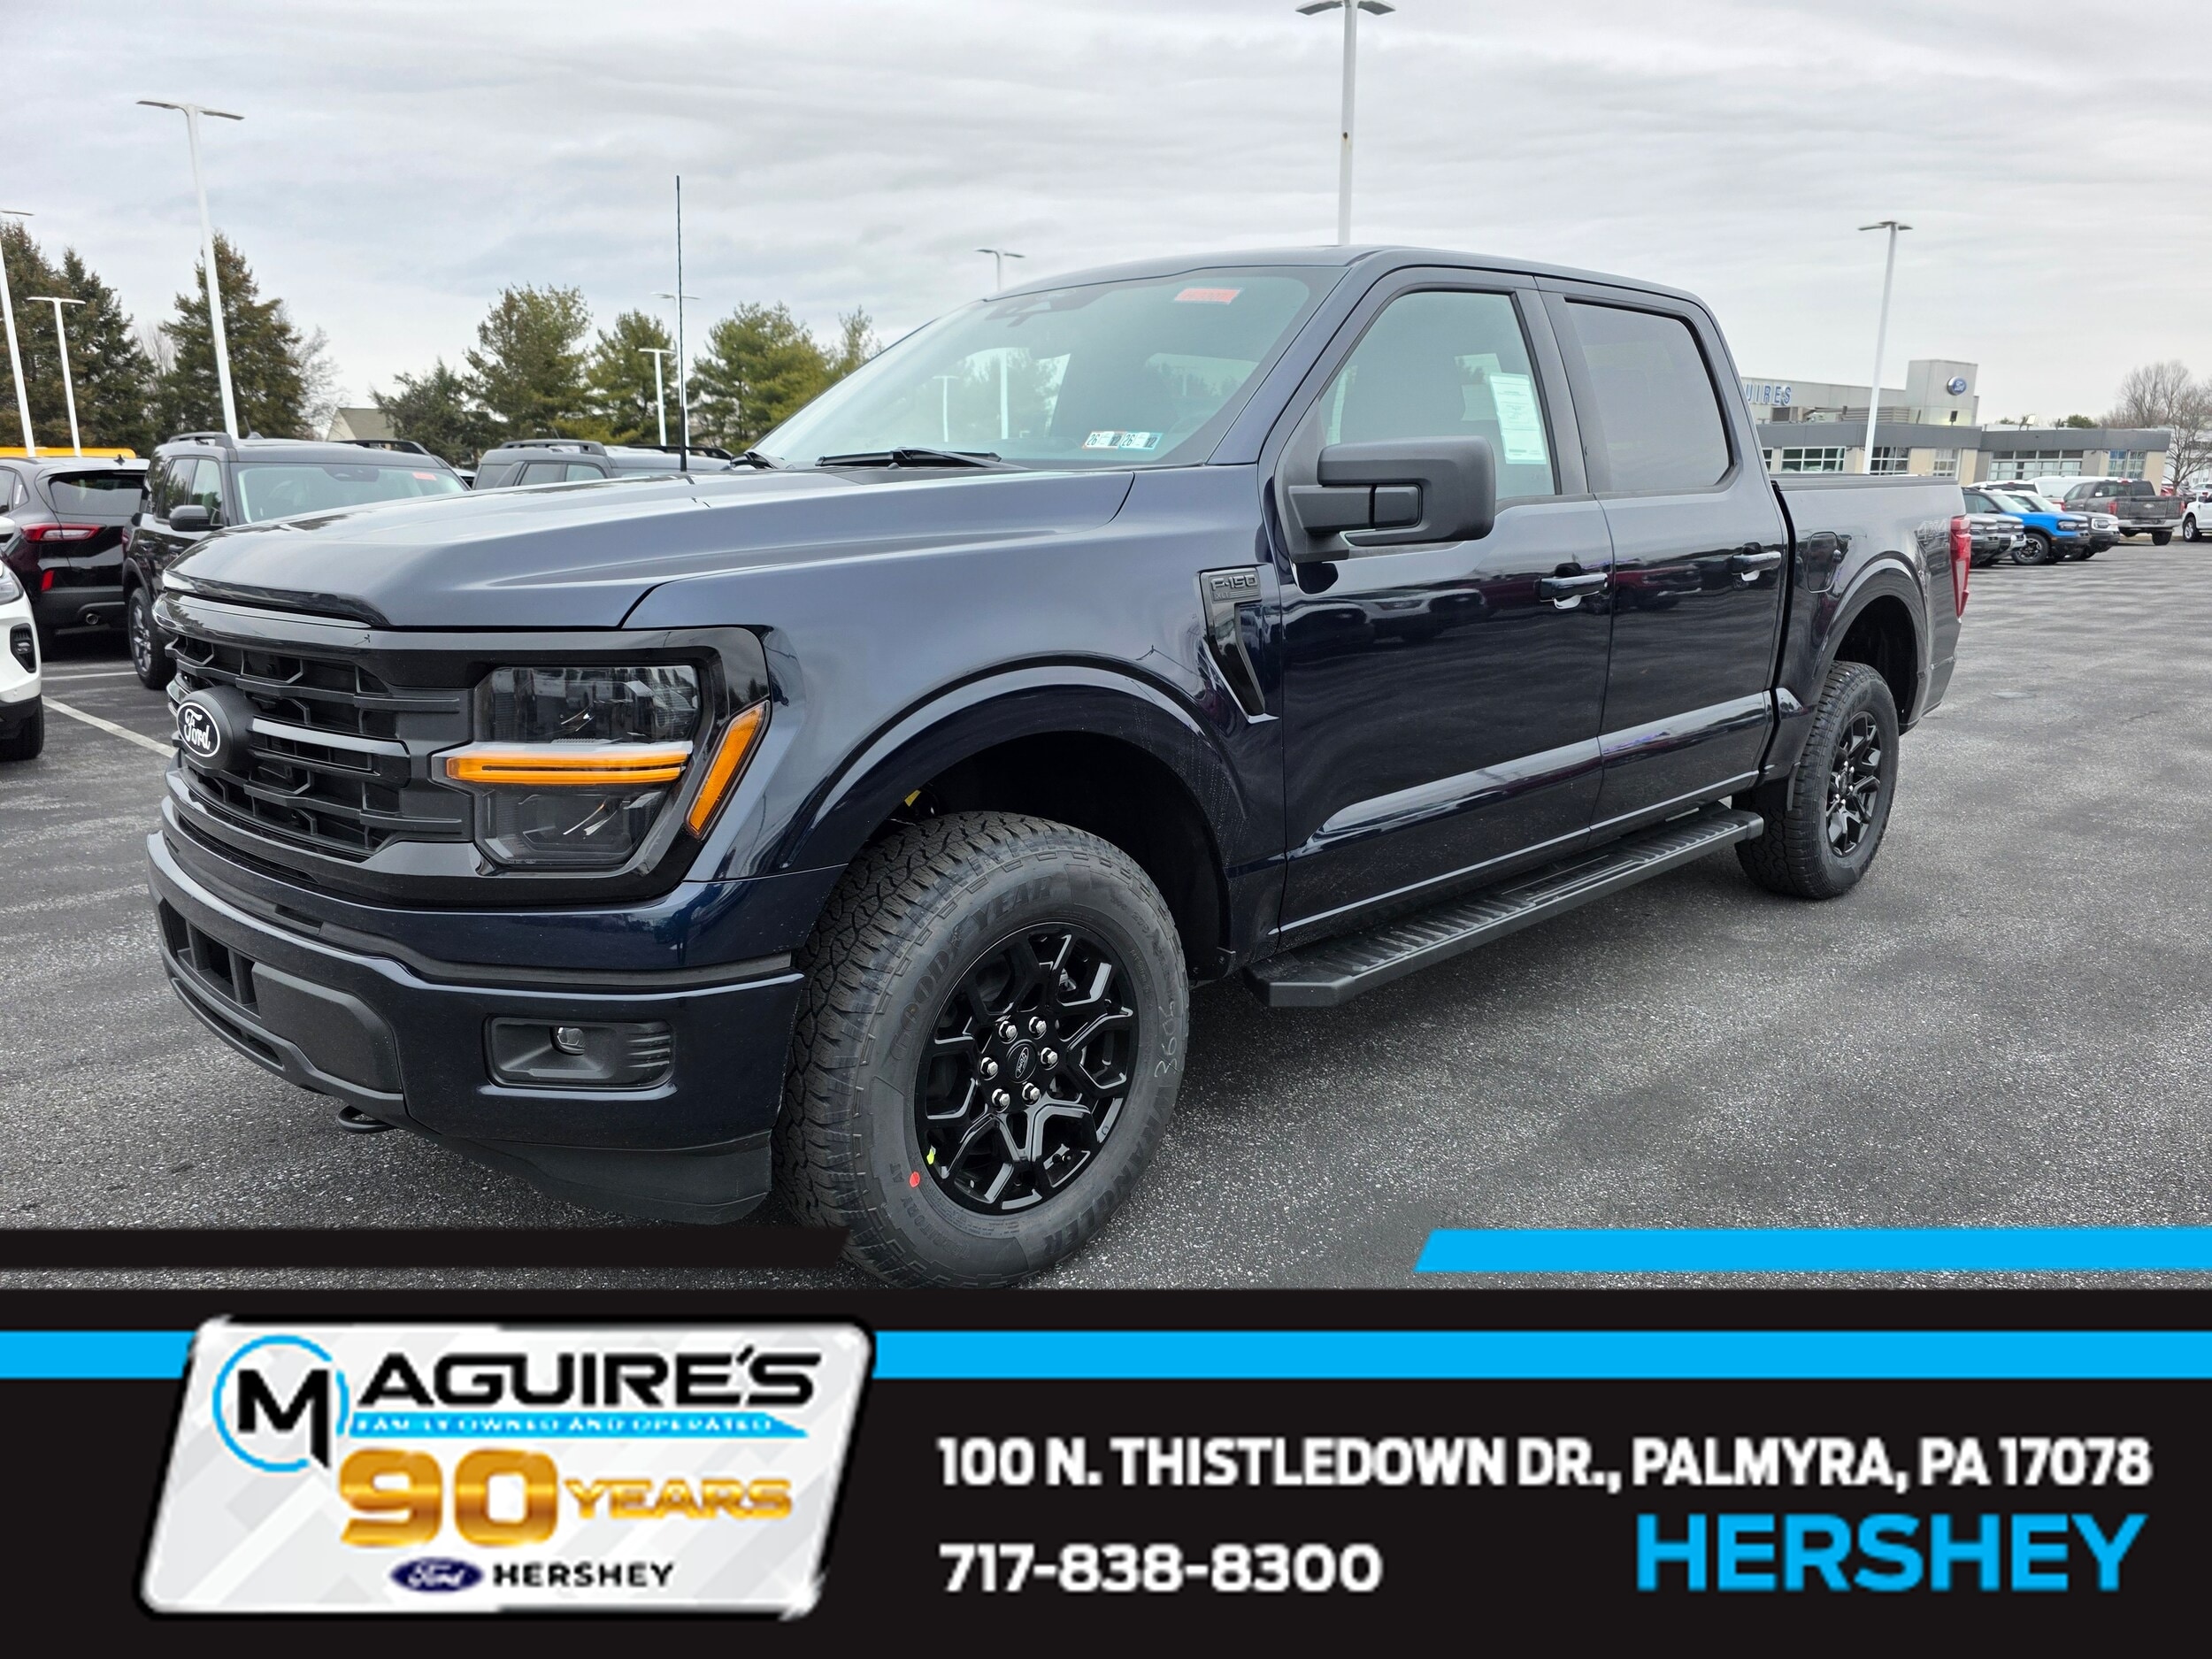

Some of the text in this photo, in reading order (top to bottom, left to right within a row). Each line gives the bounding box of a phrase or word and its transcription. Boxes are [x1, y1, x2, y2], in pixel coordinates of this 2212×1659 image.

[1210, 574, 1258, 591] F-150
[183, 708, 211, 750] Ford
[890, 874, 1054, 1061] GOODYEAR
